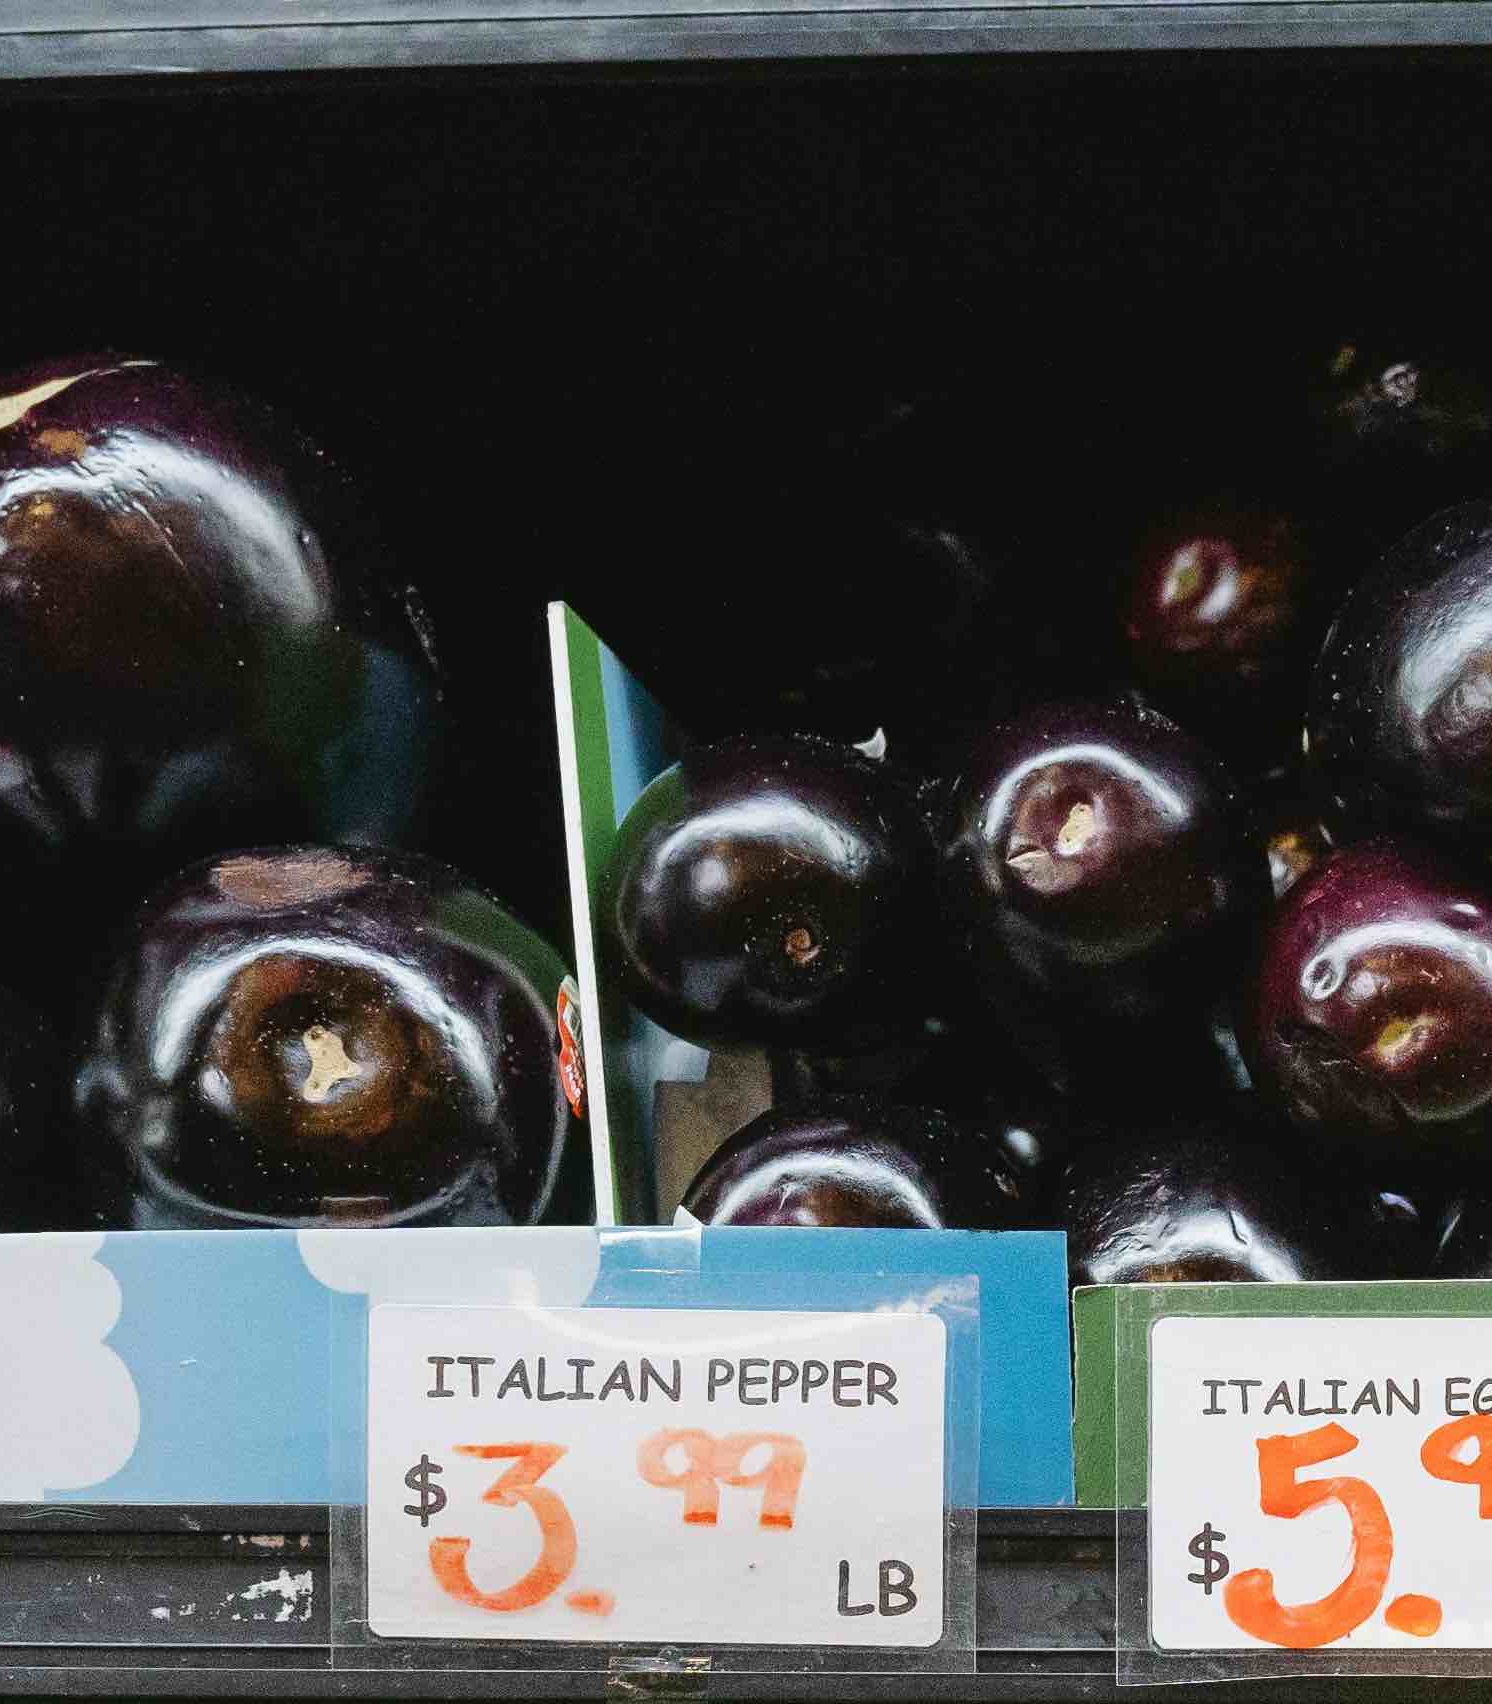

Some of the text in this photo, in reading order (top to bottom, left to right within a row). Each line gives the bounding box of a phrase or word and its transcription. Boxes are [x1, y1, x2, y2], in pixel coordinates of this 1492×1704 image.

[426, 1355, 899, 1408] ITALIAN PEPPER
[1202, 1378, 1421, 1418] ITALIAN
[836, 1558, 919, 1617] LB
